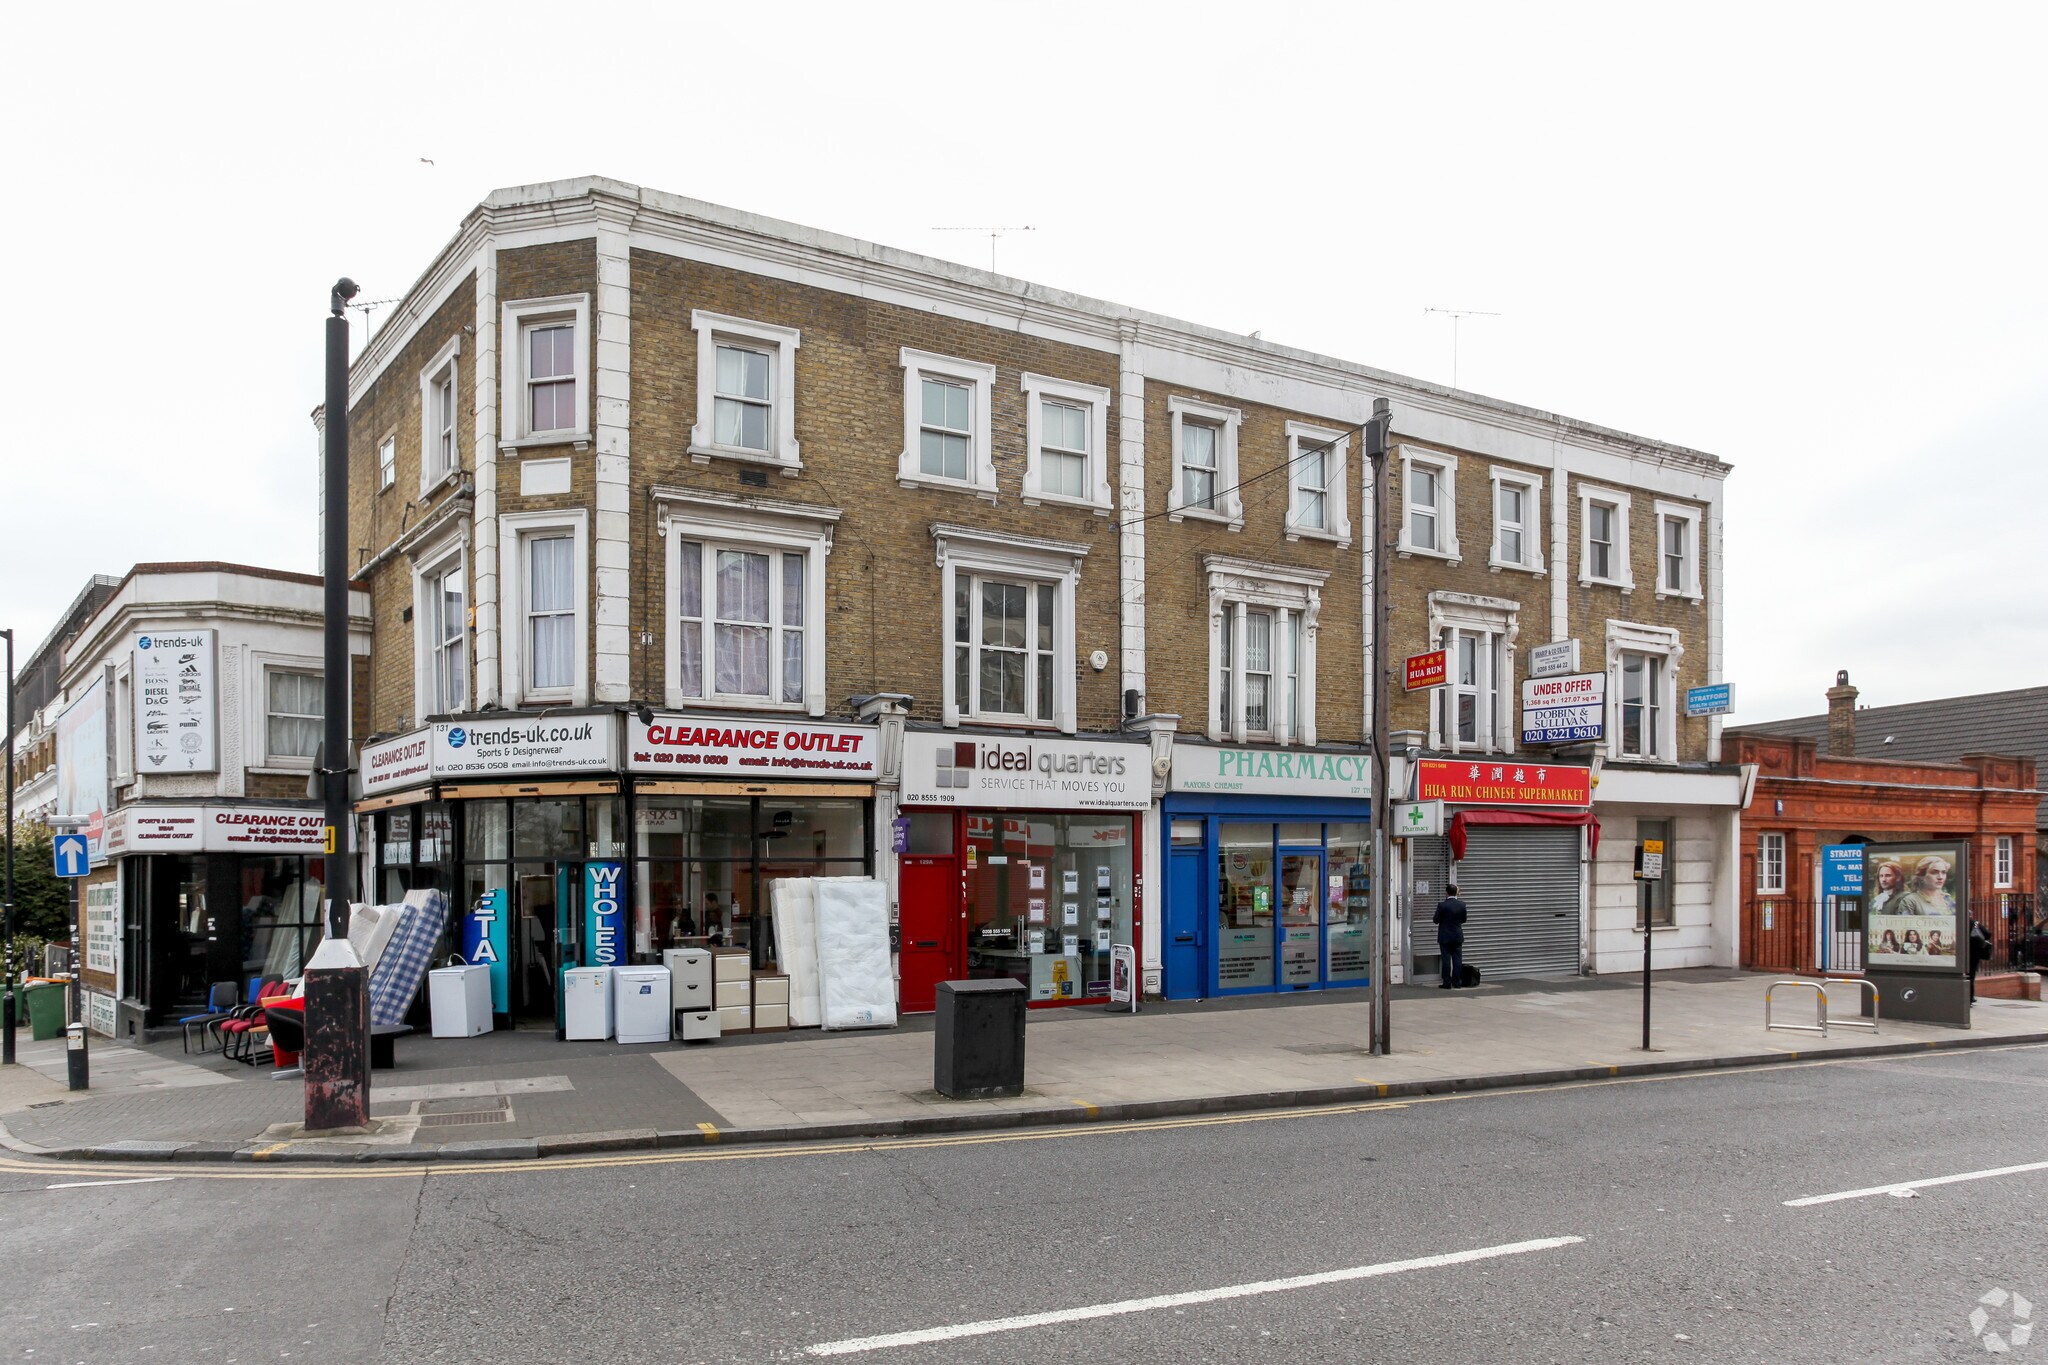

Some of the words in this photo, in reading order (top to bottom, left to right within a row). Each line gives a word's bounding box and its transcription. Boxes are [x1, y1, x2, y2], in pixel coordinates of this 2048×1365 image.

[154, 636, 203, 648] trends-uk
[1410, 669, 1425, 679] HUA
[1426, 665, 1442, 676] RUN
[1534, 682, 1562, 696] UNDER
[1565, 679, 1592, 693] OFFER
[146, 697, 168, 705] D&G
[1535, 709, 1576, 720] DOBBIN
[1580, 708, 1588, 716] &
[436, 724, 449, 732] 131
[1535, 716, 1588, 728] SULLIVAN
[470, 723, 593, 746] trends-uk.co.uk
[647, 725, 779, 749] CLEARANCE
[784, 731, 863, 753] OUTLET
[1525, 731, 1544, 741] 020
[1546, 728, 1570, 740] 8221
[1573, 726, 1598, 738] 9610
[372, 748, 403, 768] CLEARANCE
[404, 741, 426, 760] OUTLET
[477, 749, 502, 758] Sports
[504, 748, 511, 756] &
[512, 746, 563, 757] Designerwear
[487, 762, 509, 770] 0508
[633, 752, 652, 763] tel:
[653, 752, 673, 763] 020
[675, 753, 702, 764] 8536
[739, 756, 769, 766] email:
[771, 757, 873, 771] info@trends-uk.co.uk
[981, 743, 1032, 772] ideal
[1037, 750, 1126, 778] quarters
[1217, 750, 1369, 782] PHARMACY
[1468, 764, 1547, 784] 華潤超市
[981, 777, 1025, 790] SERVICE
[1029, 779, 1057, 791] THAT
[1061, 780, 1099, 792] MOVES
[1103, 782, 1126, 793] YOU
[1183, 781, 1211, 789] MAYORS
[1214, 782, 1244, 790] CHEMIST
[907, 793, 920, 801] 020
[920, 794, 938, 802] 8555
[939, 794, 955, 802] 1909
[1425, 784, 1447, 797] HUA
[1451, 786, 1472, 797] RUN
[1476, 787, 1516, 799] CHINESE
[1519, 788, 1584, 801] SUPERMARKET
[1079, 798, 1149, 808] www.idealquarters.com
[216, 813, 296, 827] CLEARANCE
[298, 817, 326, 828] OUT
[248, 827, 260, 835] tel:
[1402, 825, 1429, 833] Pharmacy
[254, 836, 325, 844] info@trends-uk.co
[1830, 849, 1862, 858] STRATFO
[1843, 874, 1863, 882] TEL:
[588, 867, 622, 968] WHOLES
